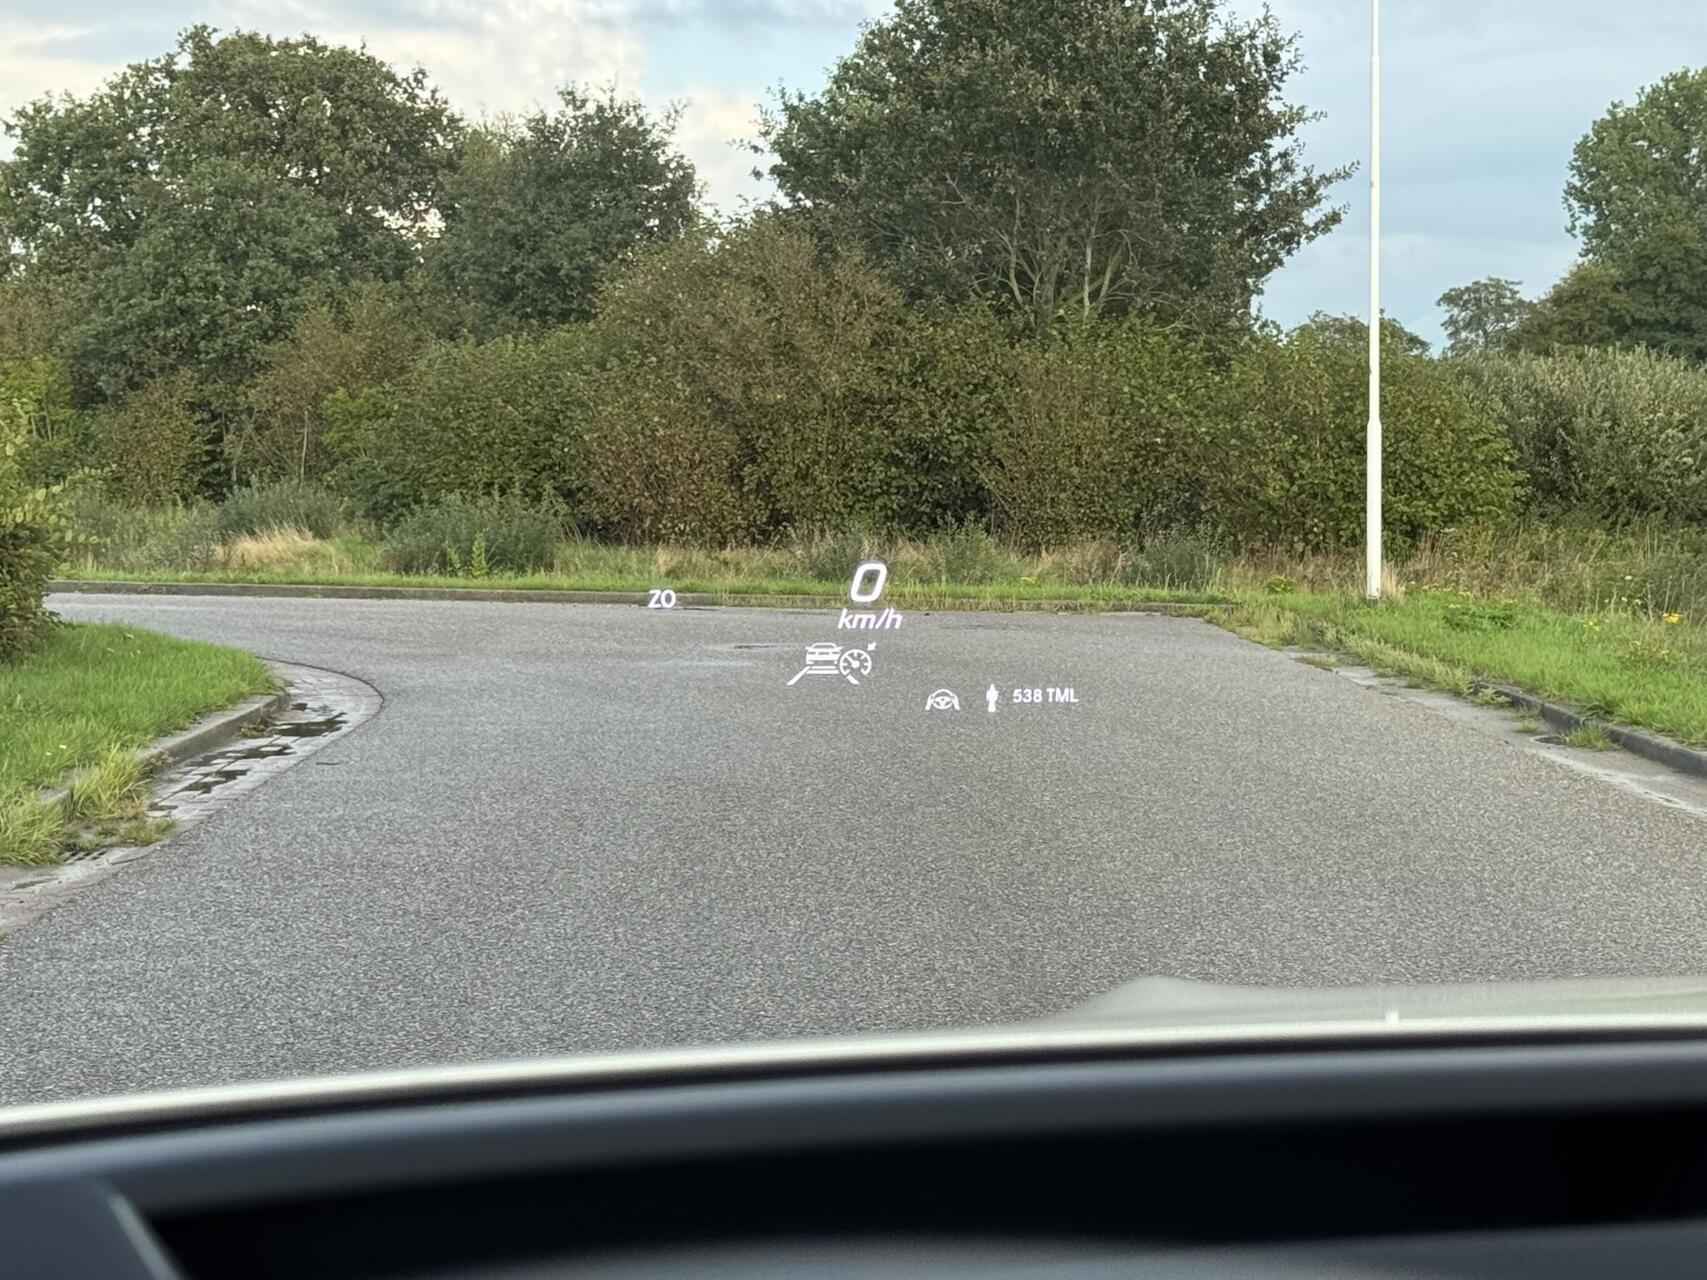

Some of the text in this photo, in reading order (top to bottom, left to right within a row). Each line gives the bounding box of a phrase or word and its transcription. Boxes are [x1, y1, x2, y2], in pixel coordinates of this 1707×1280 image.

[850, 561, 888, 603] 0
[837, 607, 904, 630] km/h
[1012, 687, 1079, 704] 538 TML
